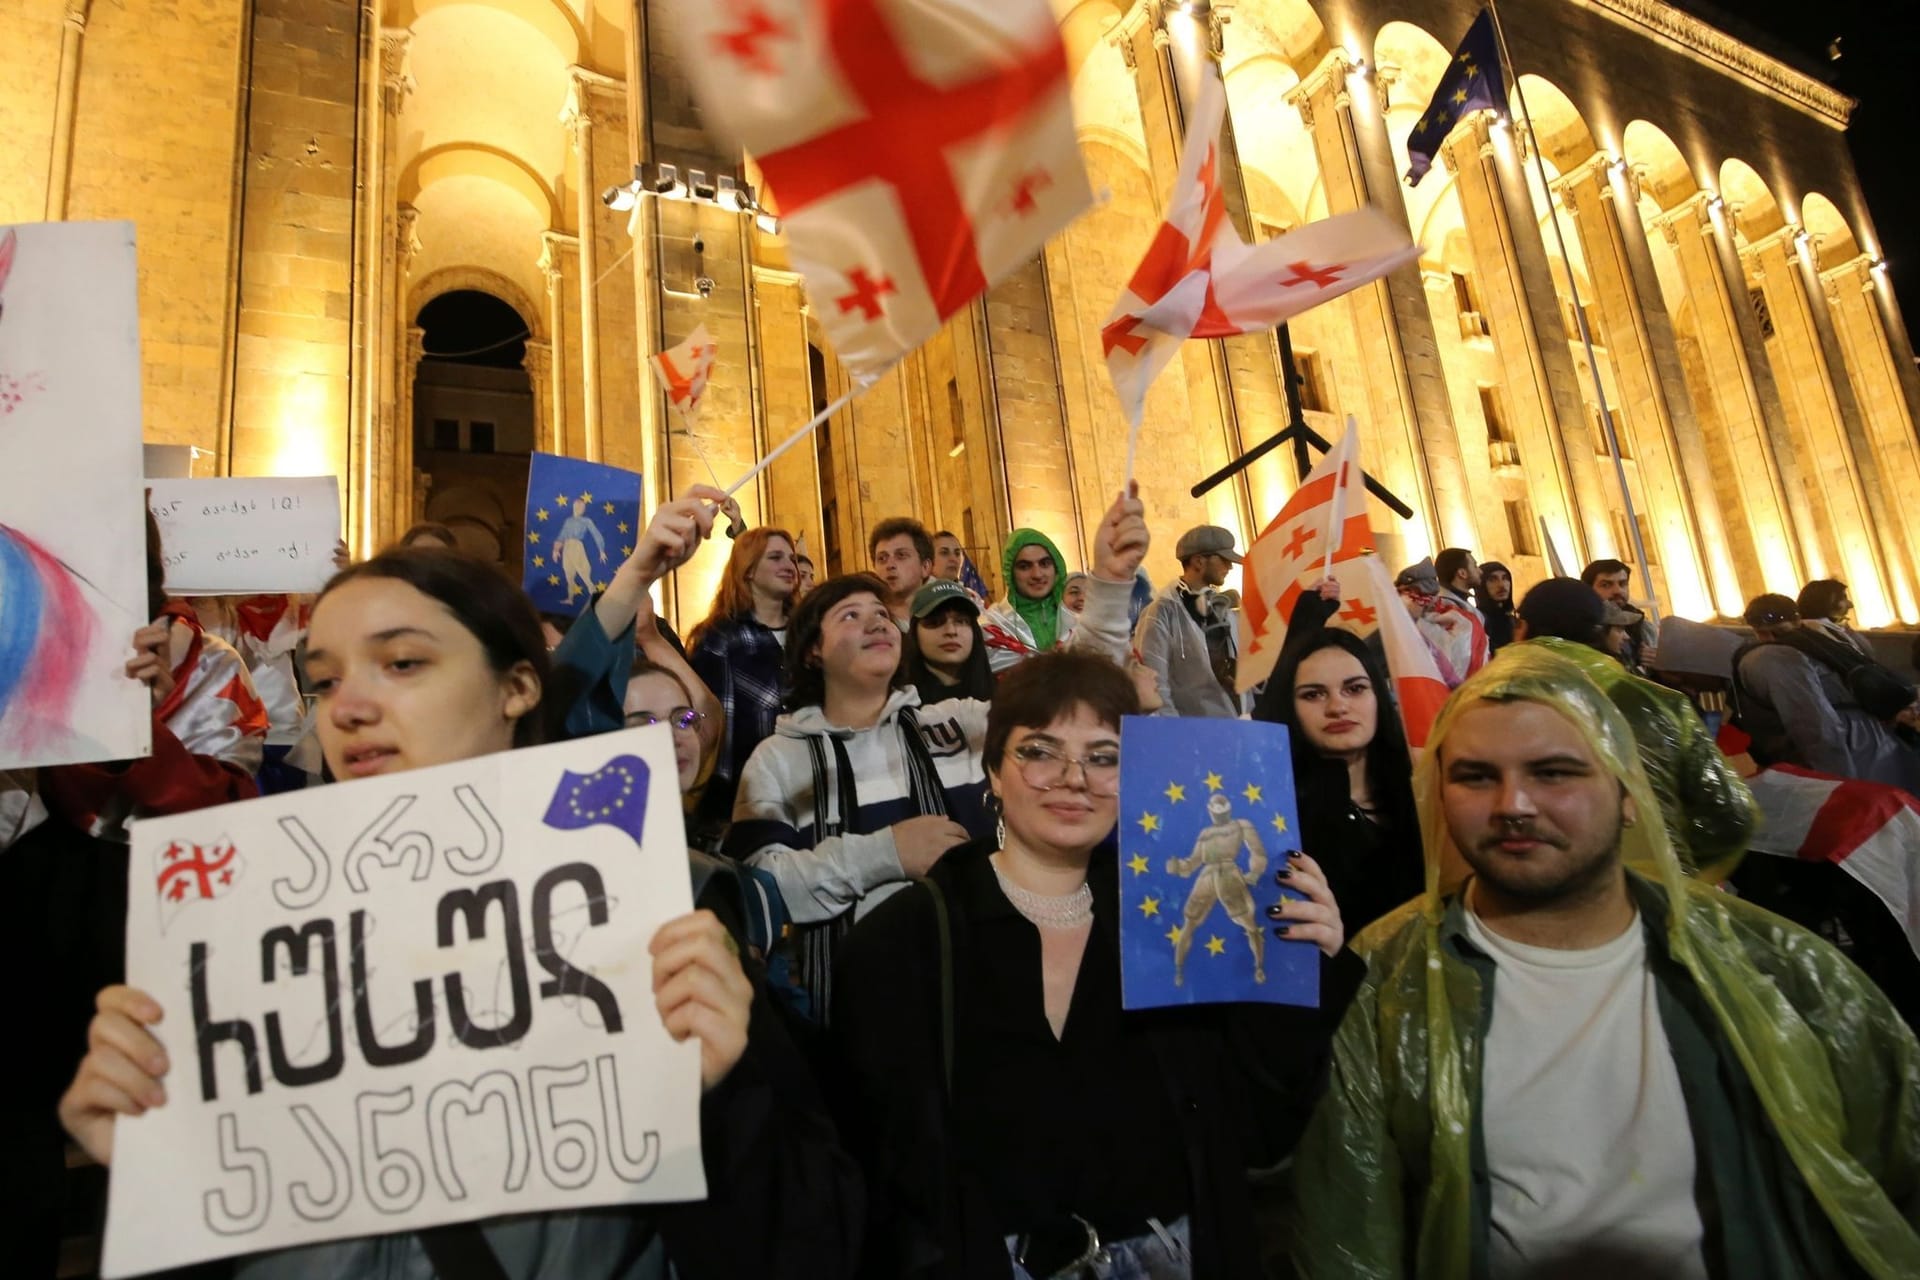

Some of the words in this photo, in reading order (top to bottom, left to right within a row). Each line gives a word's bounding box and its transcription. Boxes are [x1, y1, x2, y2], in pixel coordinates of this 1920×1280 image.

[272, 785, 503, 910] არა
[189, 862, 624, 1102] რუსულ
[203, 1054, 660, 1235] კანონს
